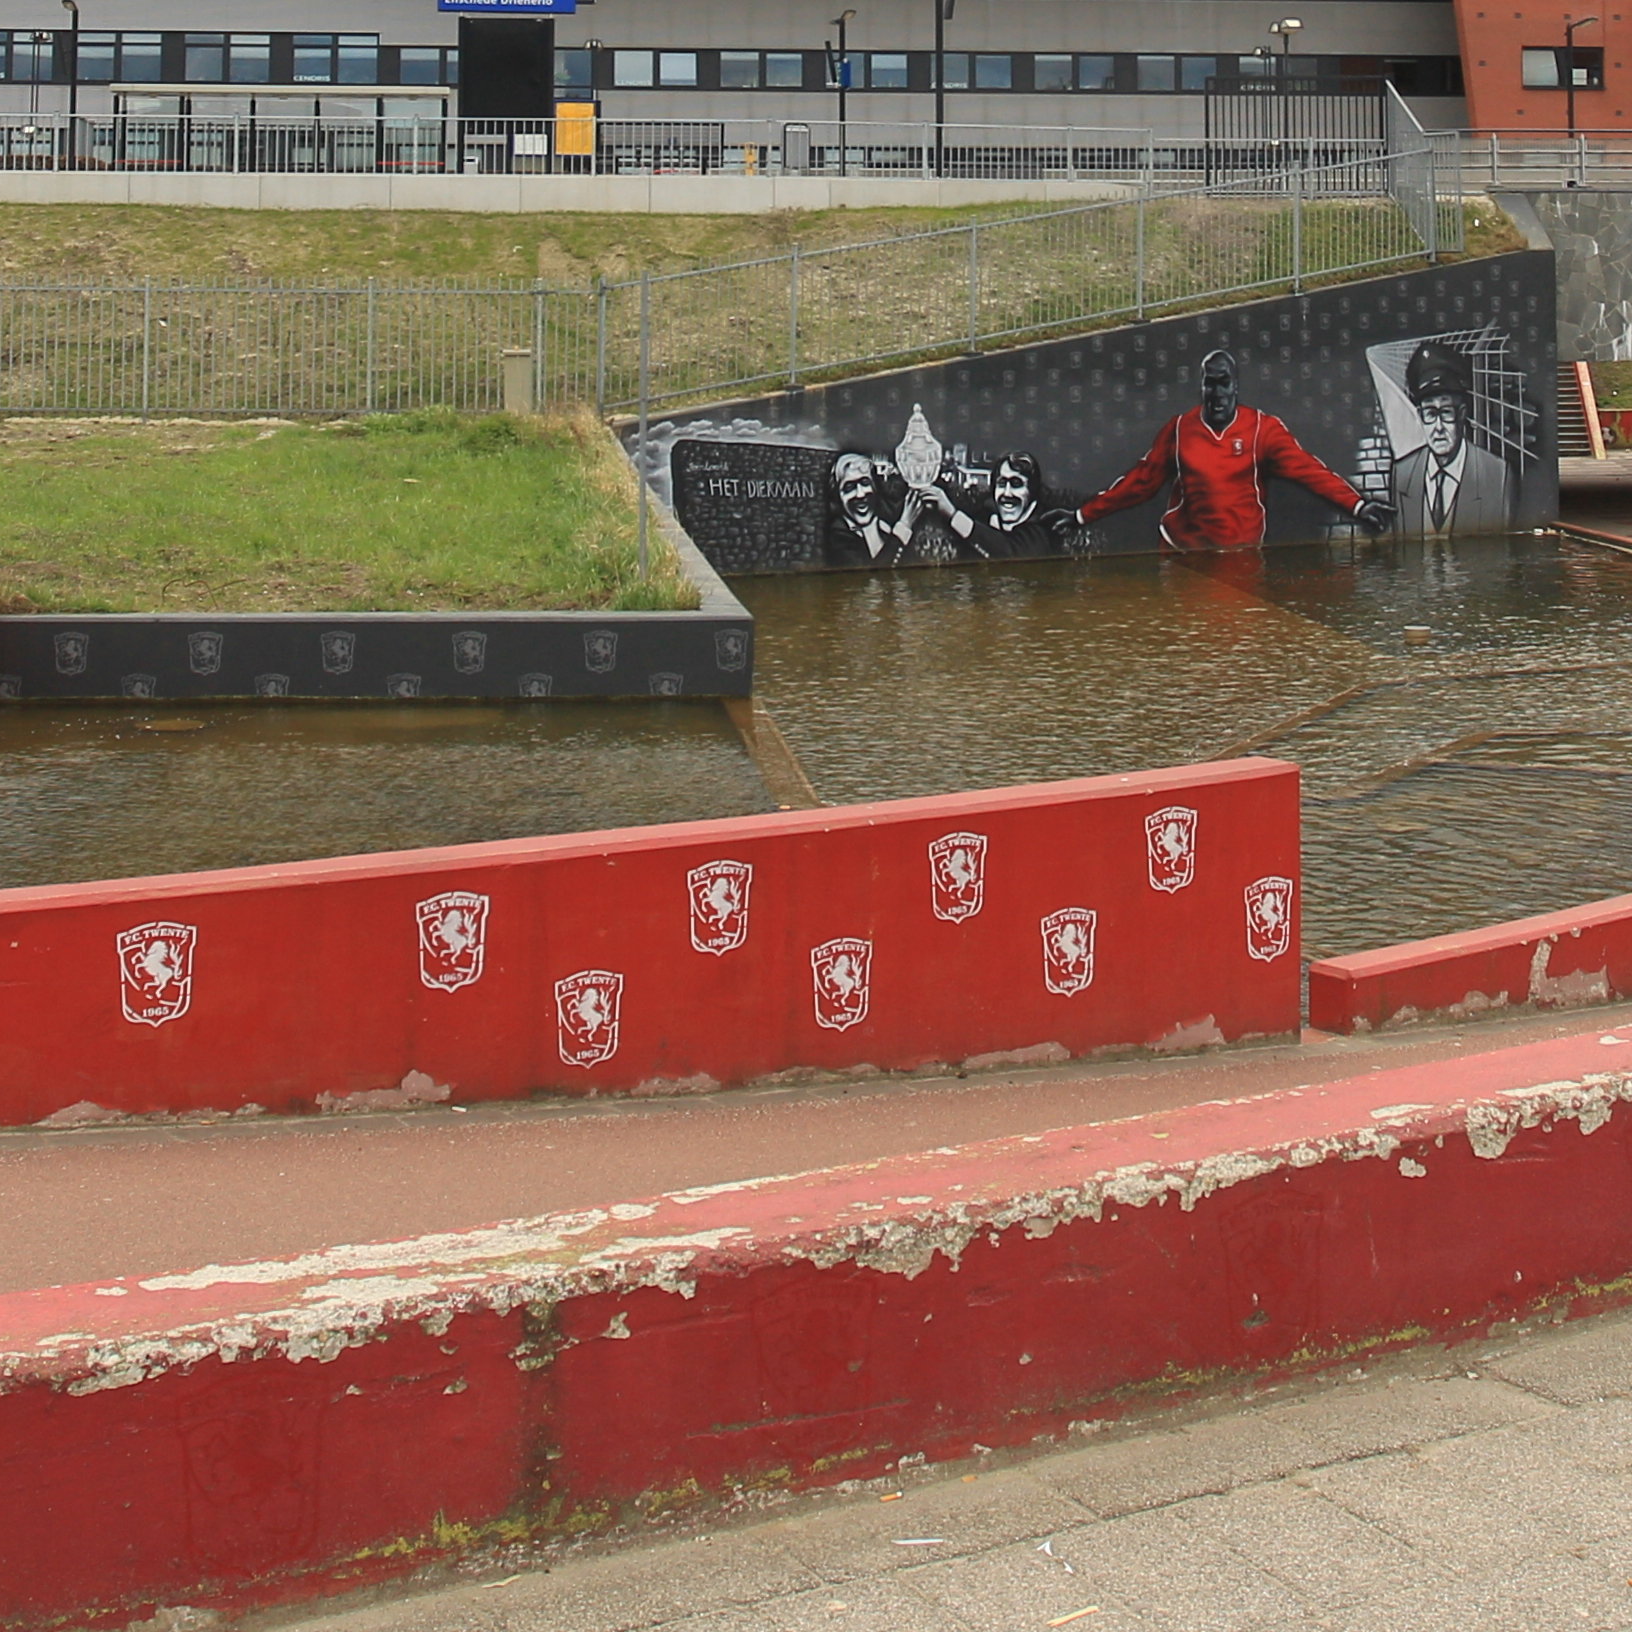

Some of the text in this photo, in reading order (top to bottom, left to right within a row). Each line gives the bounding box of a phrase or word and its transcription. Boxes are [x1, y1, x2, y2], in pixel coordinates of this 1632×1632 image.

[709, 478, 815, 499] HET DIEKMAN
[709, 865, 747, 876] TWENTE
[439, 898, 482, 909] TWENTE
[142, 927, 190, 939] TWENTE
[577, 976, 618, 987] TWENTE
